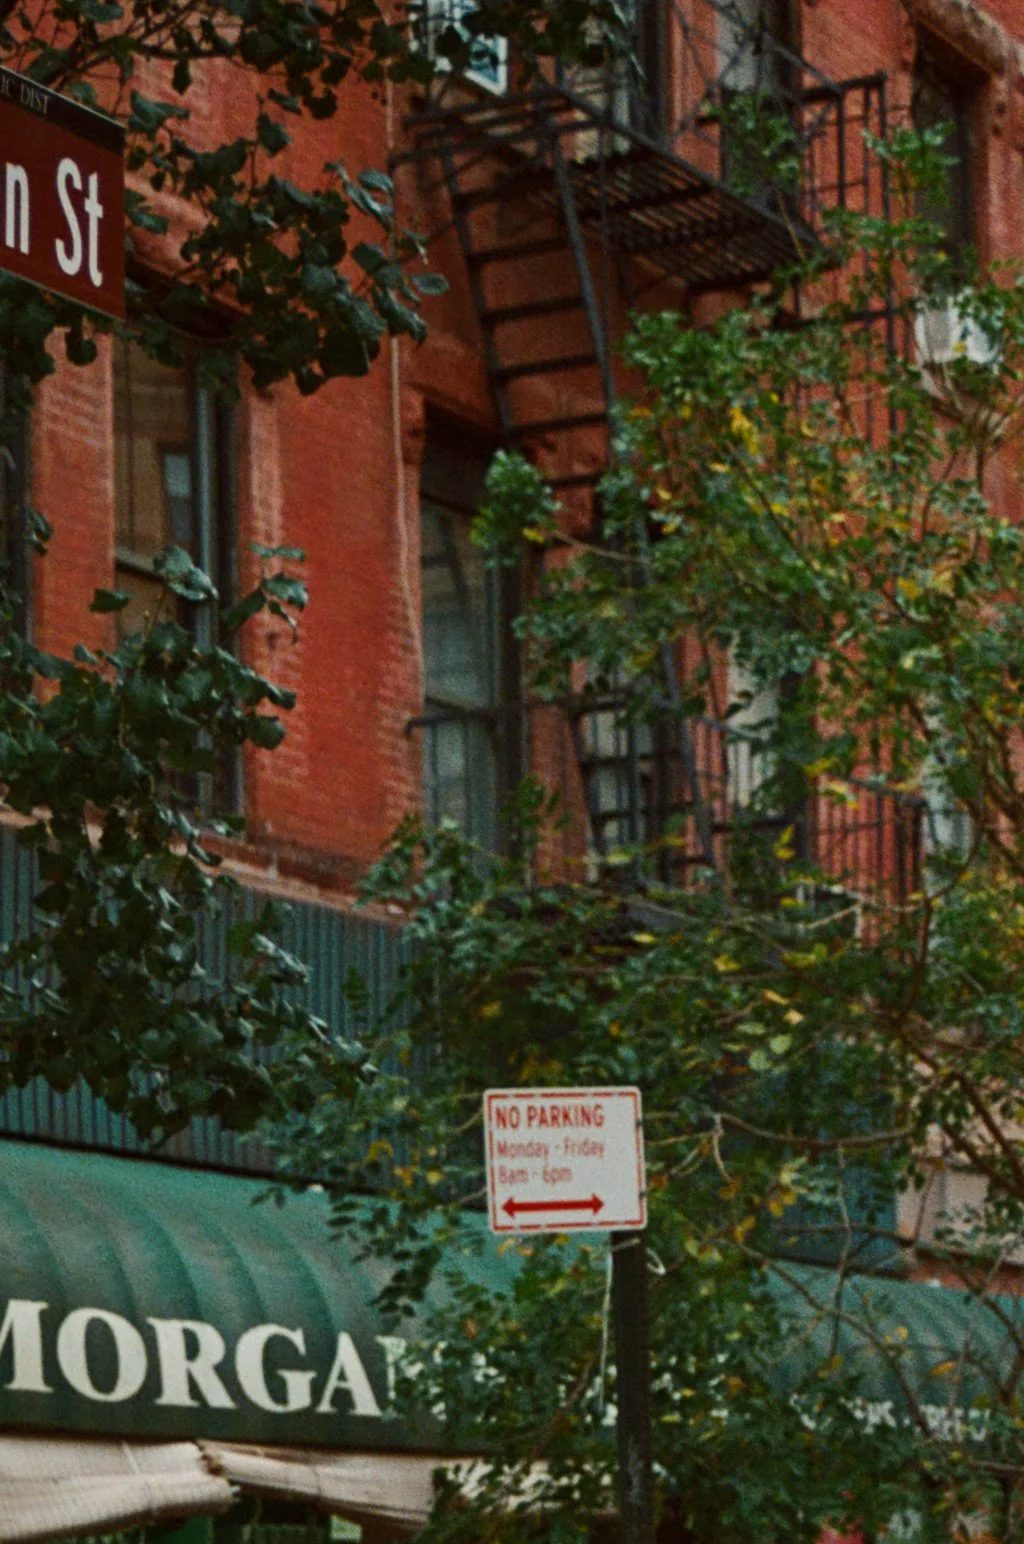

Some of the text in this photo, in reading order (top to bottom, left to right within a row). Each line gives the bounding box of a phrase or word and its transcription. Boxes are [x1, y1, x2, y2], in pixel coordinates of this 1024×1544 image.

[20, 82, 50, 114] DIST
[55, 157, 104, 288] St
[495, 1103, 604, 1129] NO PARKING
[497, 1140, 549, 1159] Monday
[563, 1136, 605, 1160] Friday
